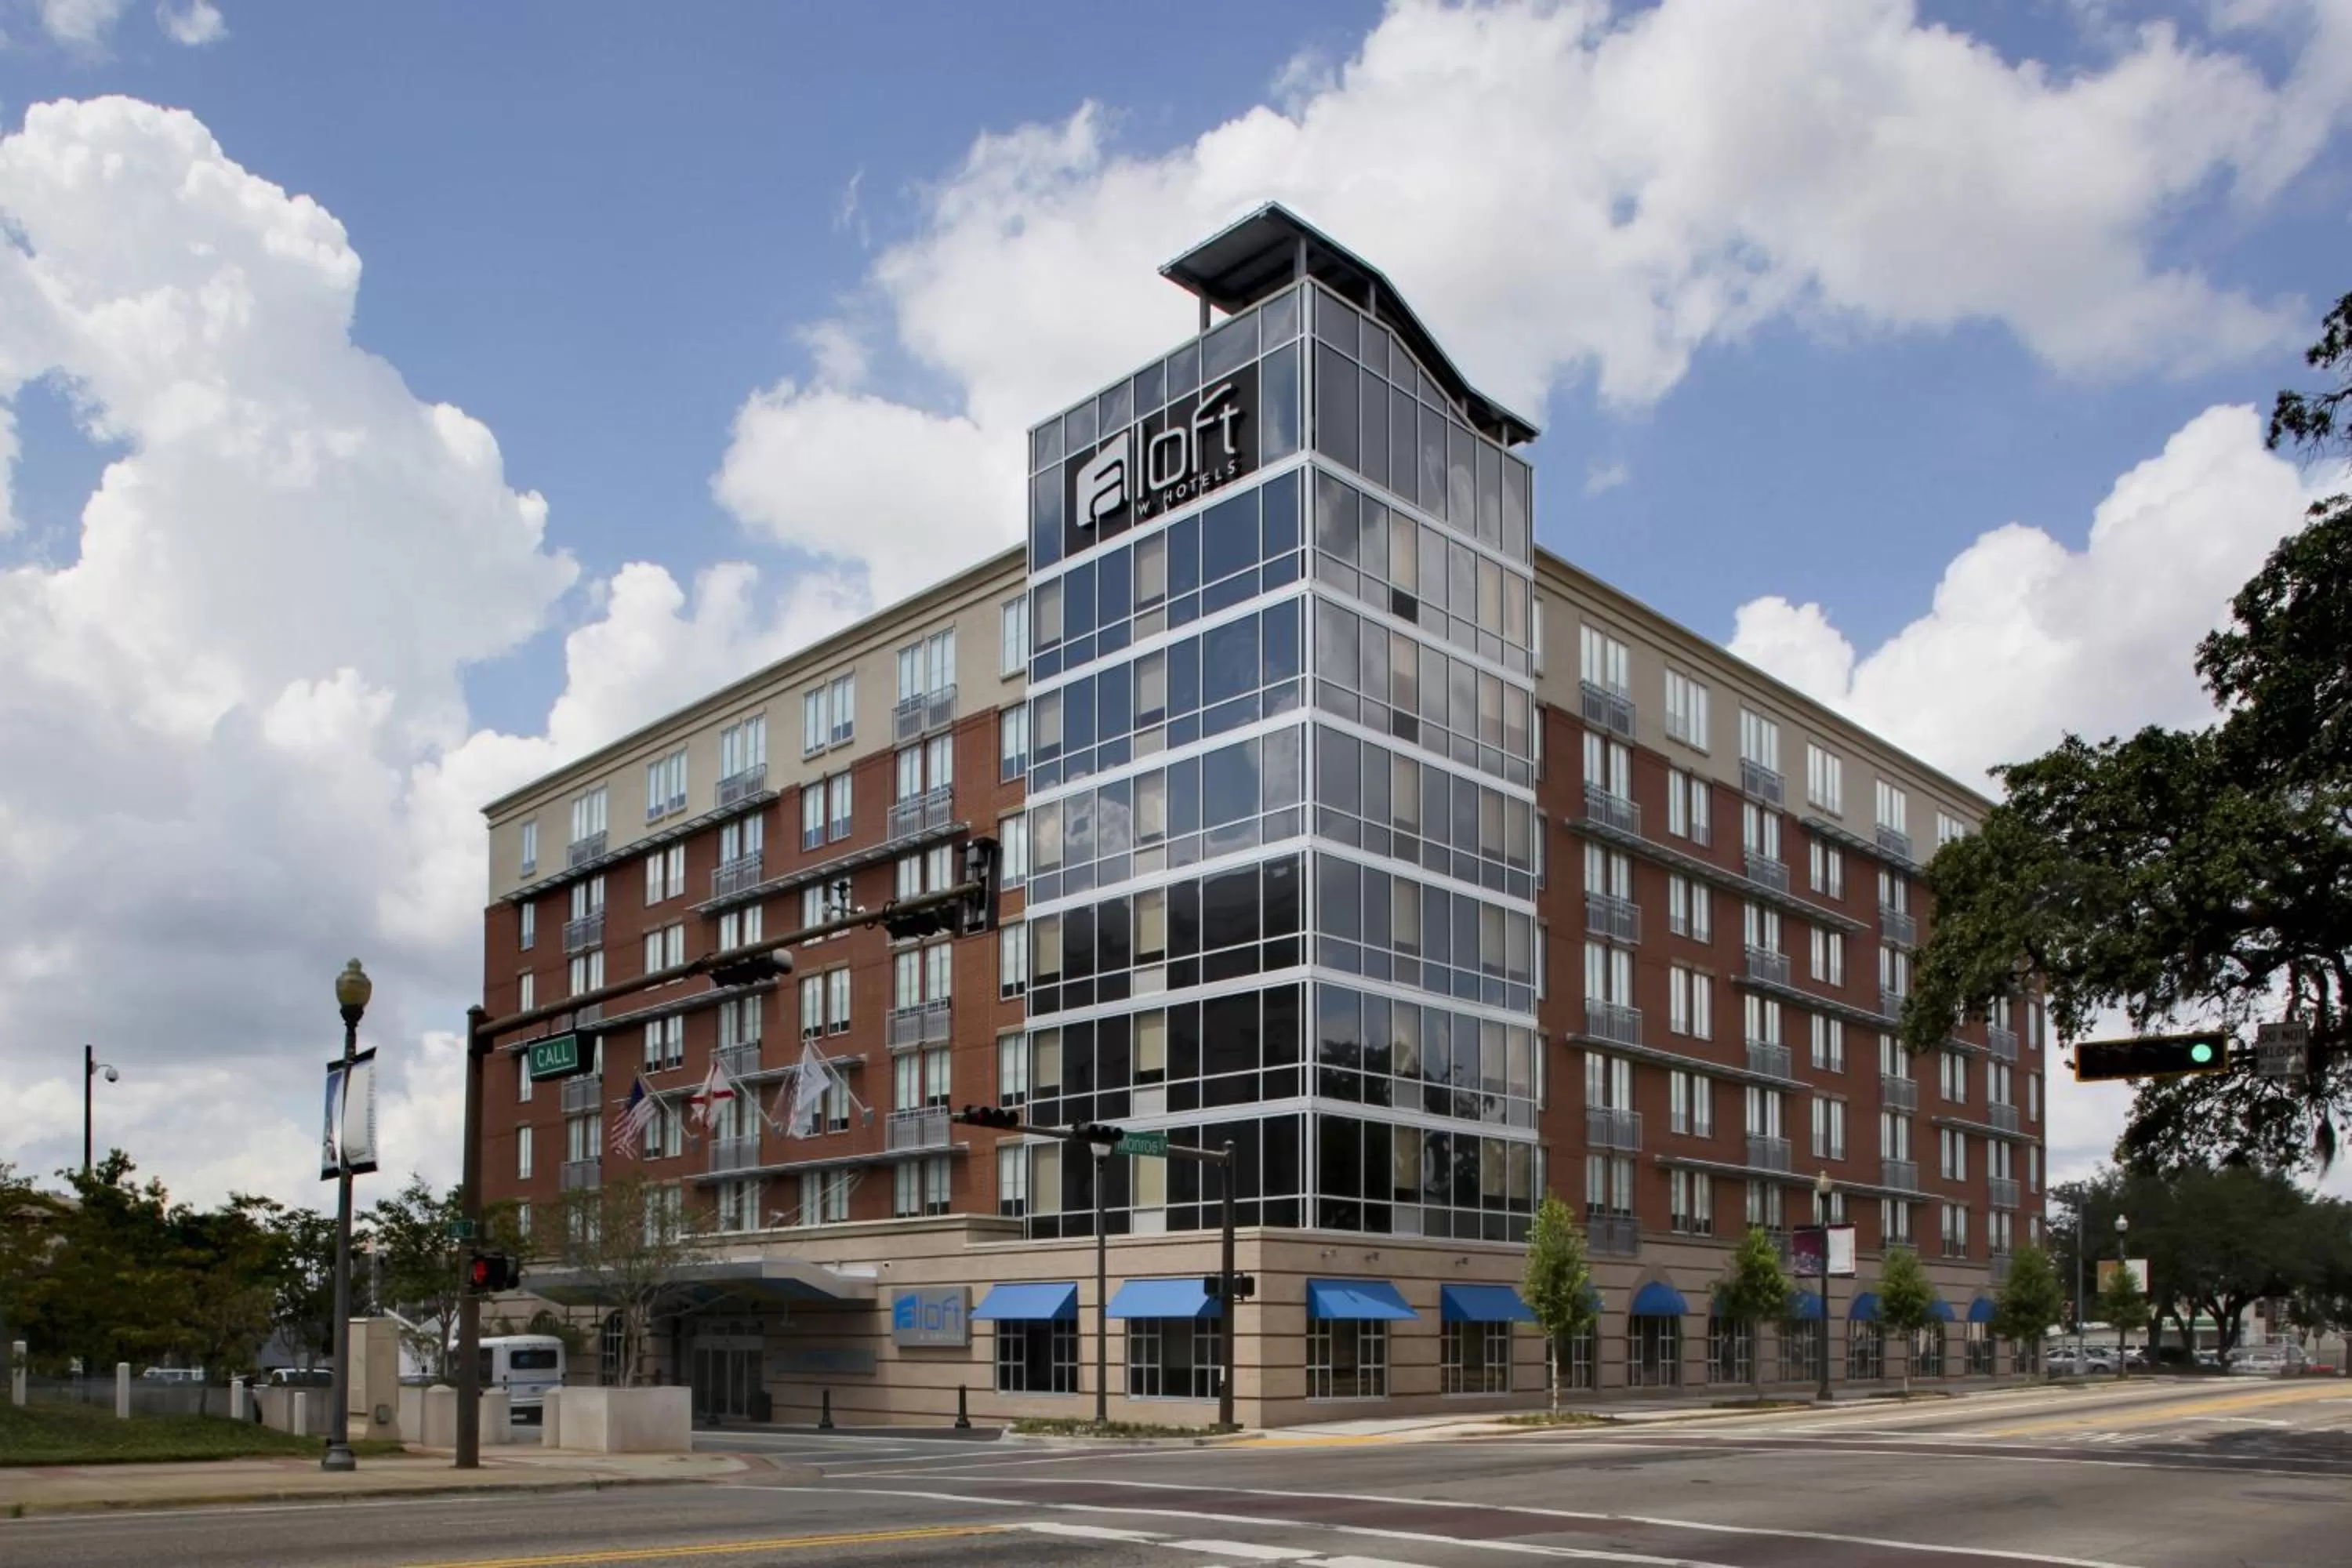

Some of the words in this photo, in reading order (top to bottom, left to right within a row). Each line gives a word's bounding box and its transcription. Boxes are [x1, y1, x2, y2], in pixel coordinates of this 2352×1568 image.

[1138, 501, 1149, 515] W
[1163, 459, 1236, 503] HOTELS
[537, 1044, 570, 1068] CALL
